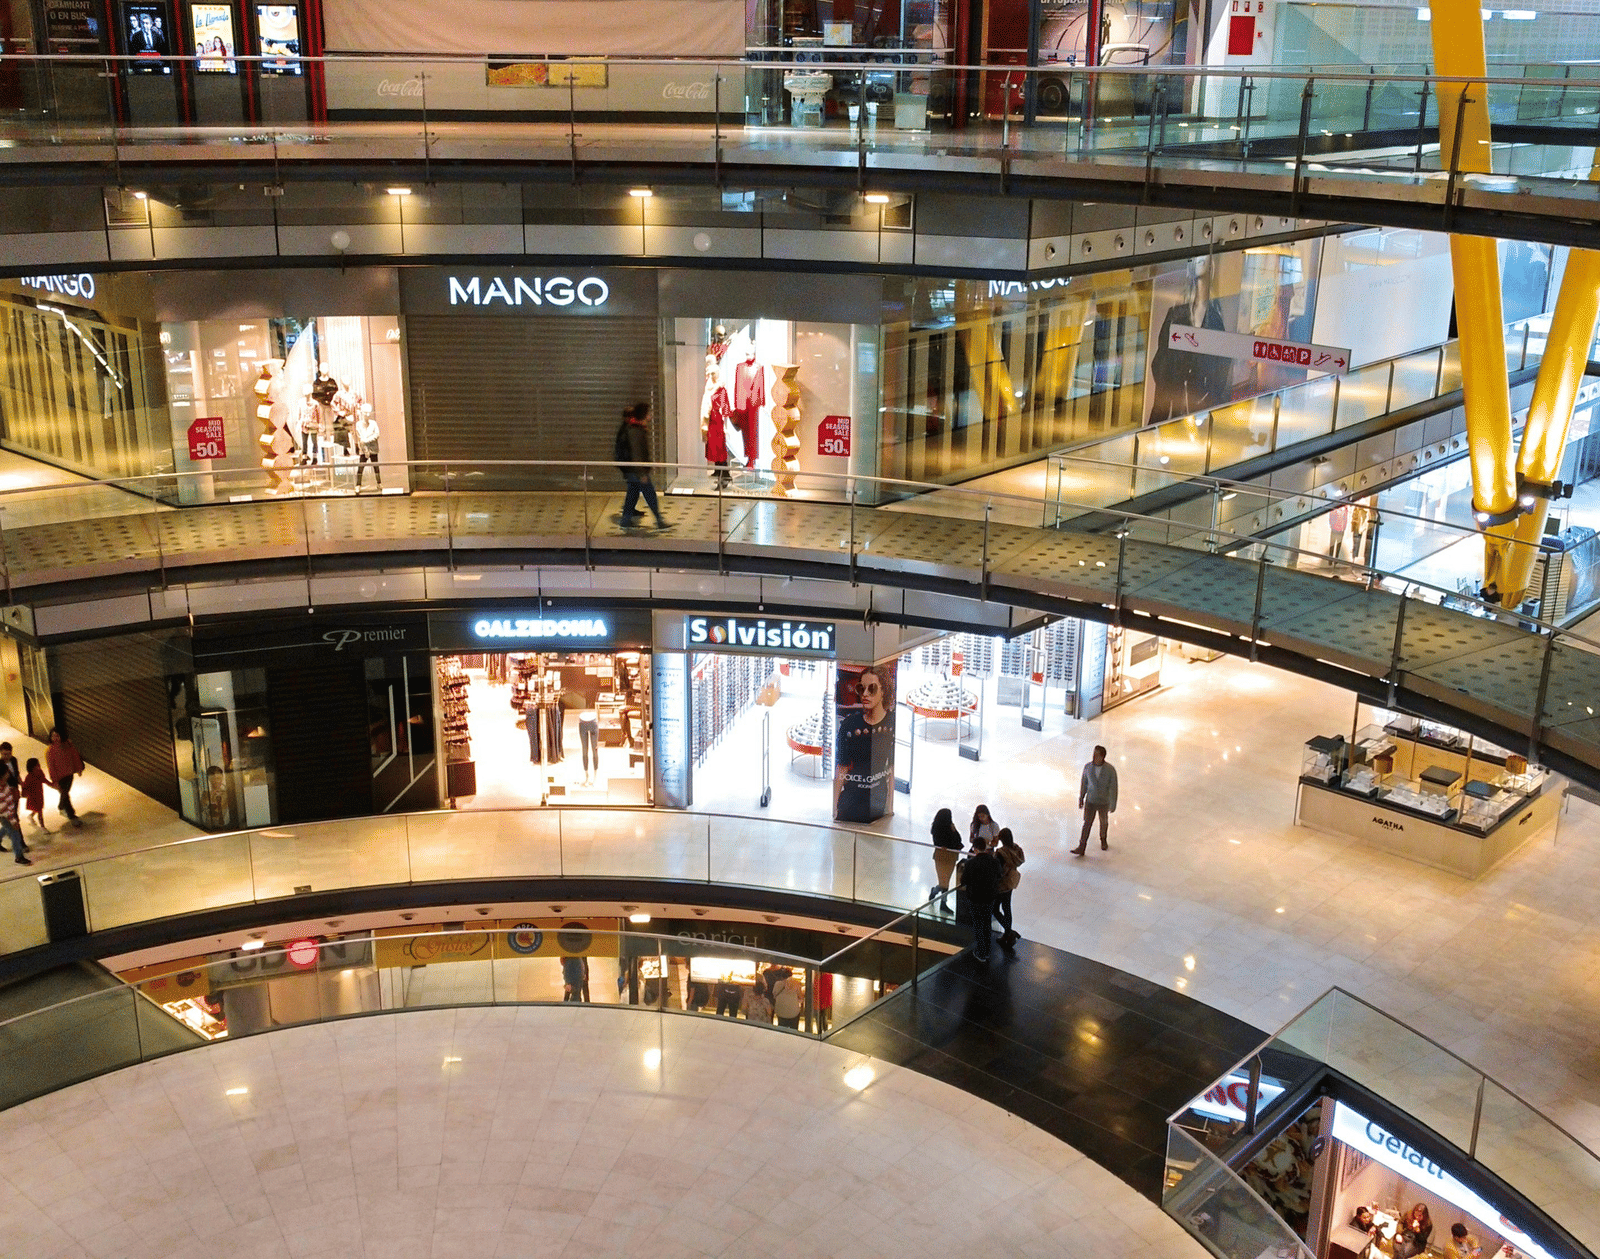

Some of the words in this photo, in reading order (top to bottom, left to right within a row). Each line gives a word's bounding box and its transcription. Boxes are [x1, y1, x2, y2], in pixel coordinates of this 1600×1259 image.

[449, 277, 609, 306] MANGO
[322, 625, 407, 652] Premier
[473, 618, 608, 638] CALZEDONIA
[690, 618, 831, 650] Solvisión
[1372, 816, 1404, 832] AGATHA
